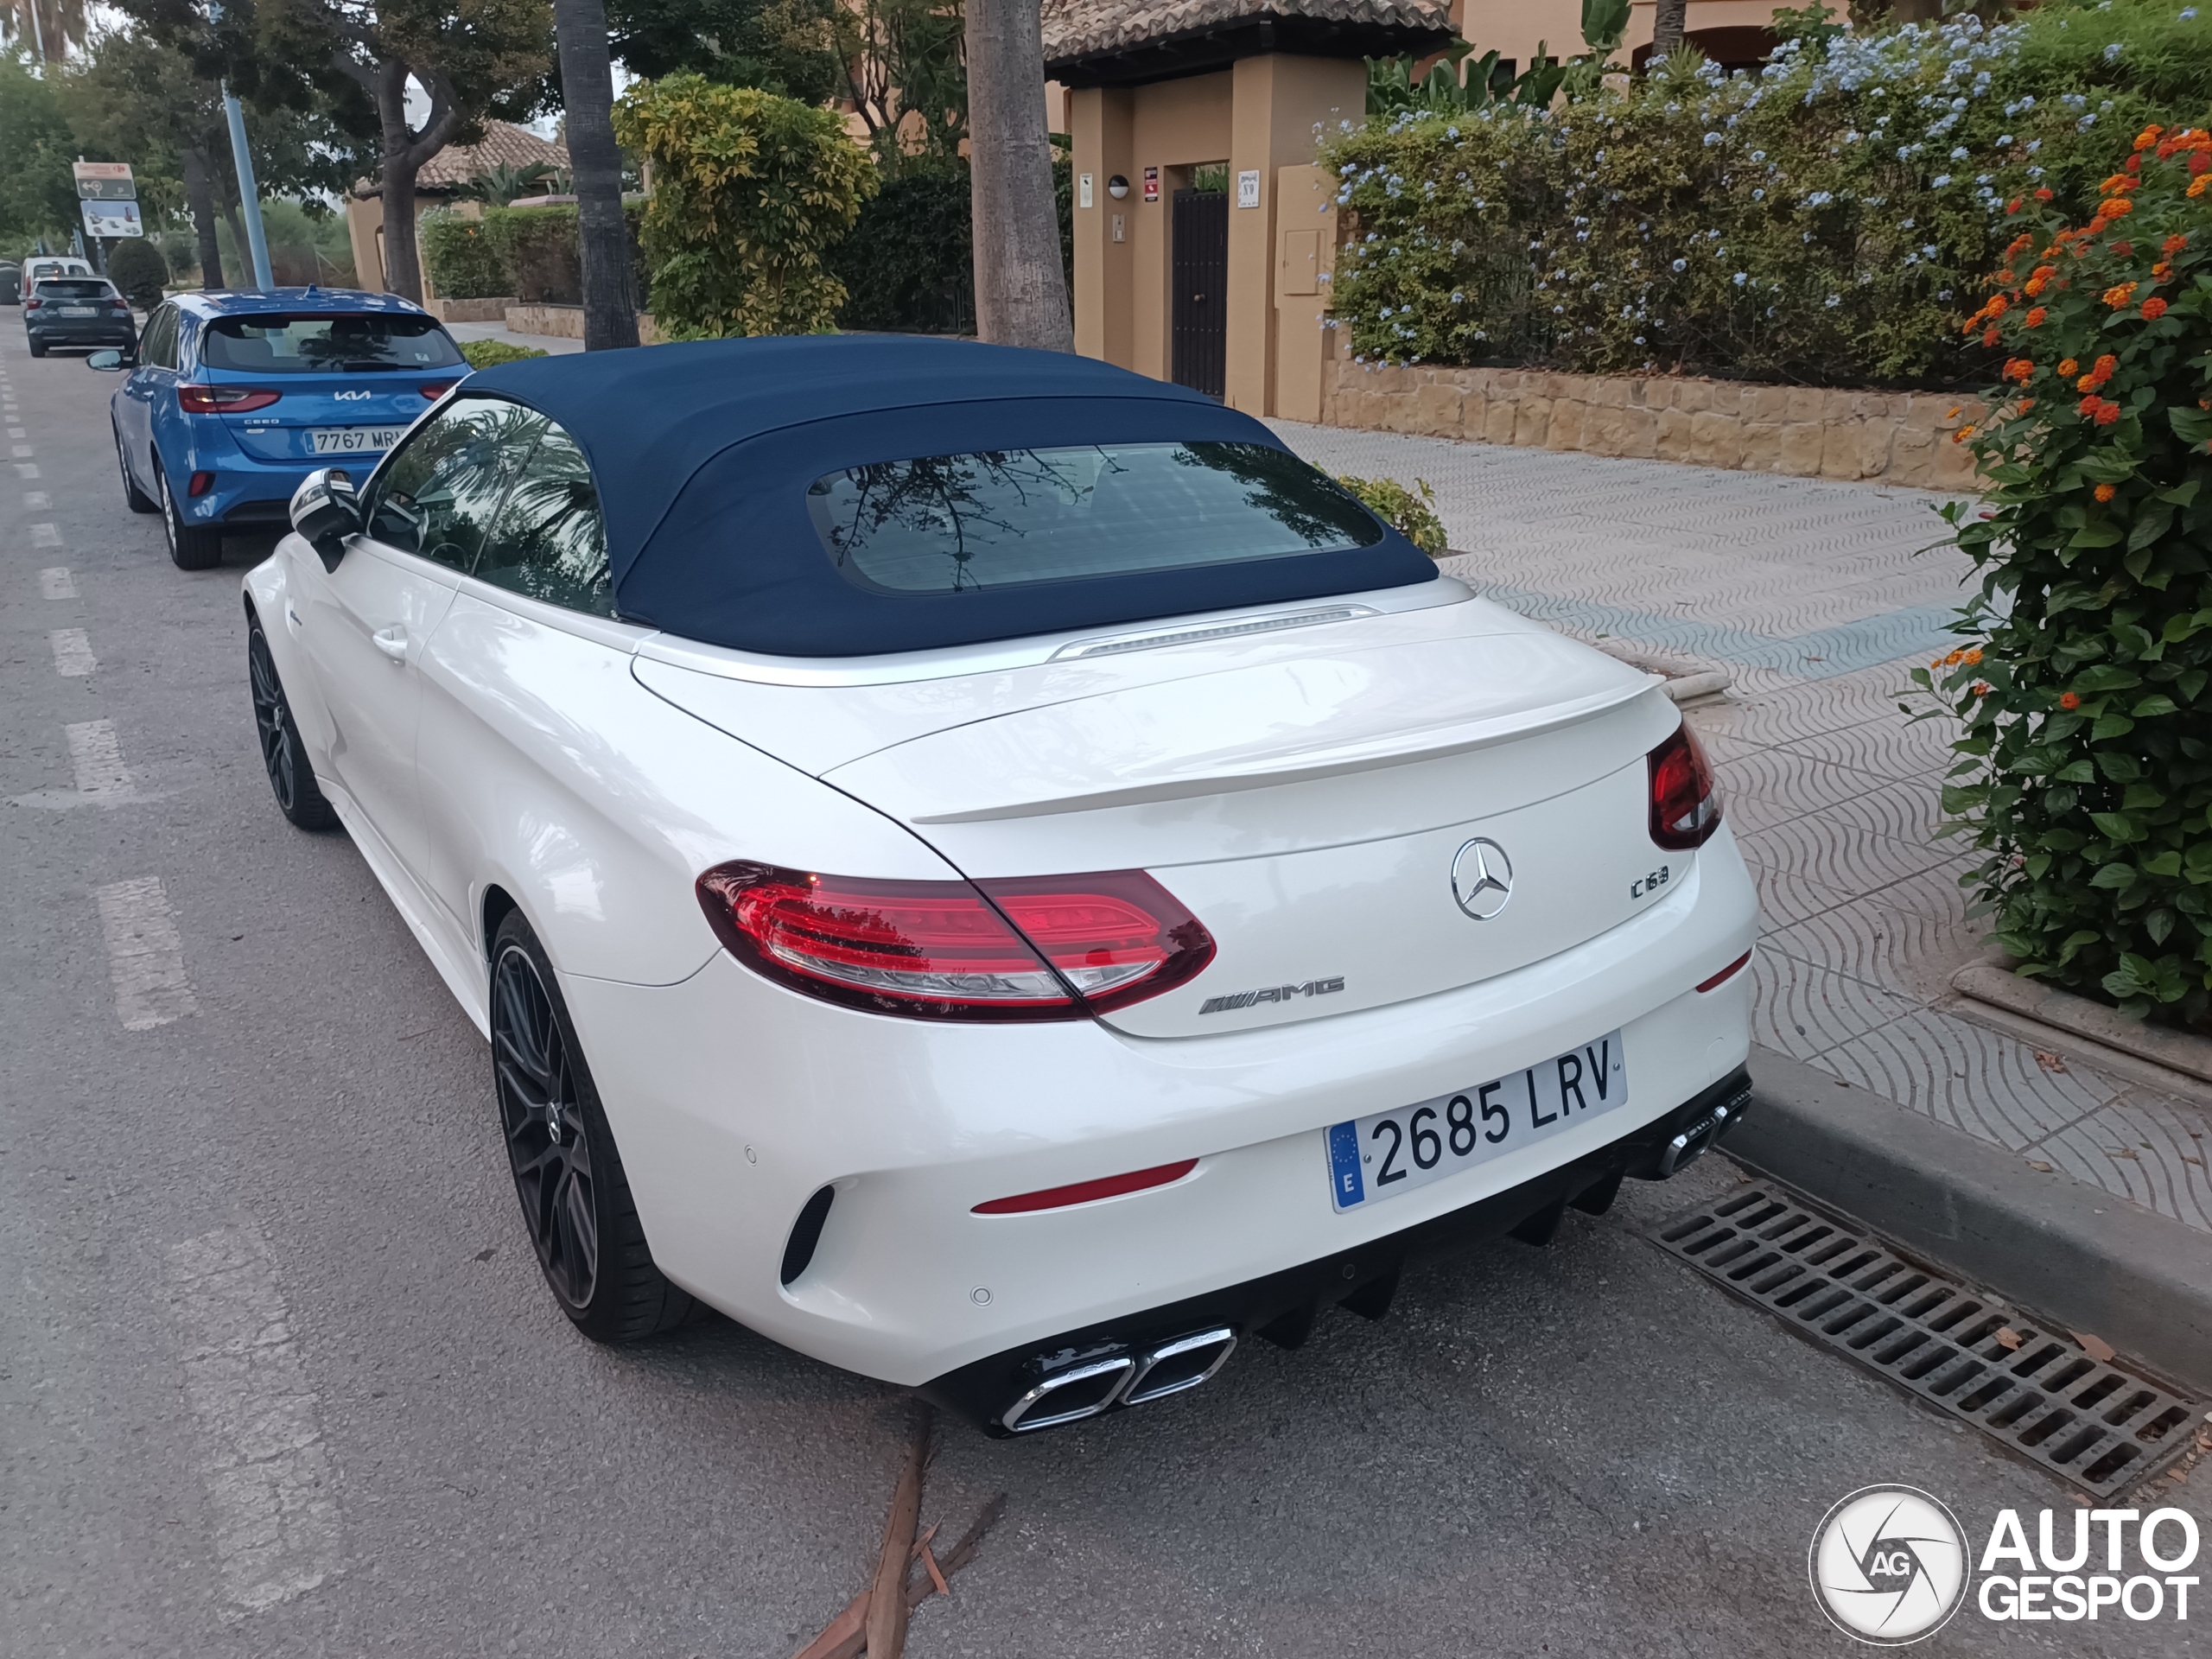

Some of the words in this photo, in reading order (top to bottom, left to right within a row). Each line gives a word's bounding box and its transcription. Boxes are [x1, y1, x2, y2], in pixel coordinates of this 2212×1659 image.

[334, 391, 372, 401] KIA
[317, 433, 365, 450] 7767
[1343, 1173, 1355, 1193] E
[1371, 1080, 1510, 1187] 2685
[1526, 1039, 1608, 1128] LRV
